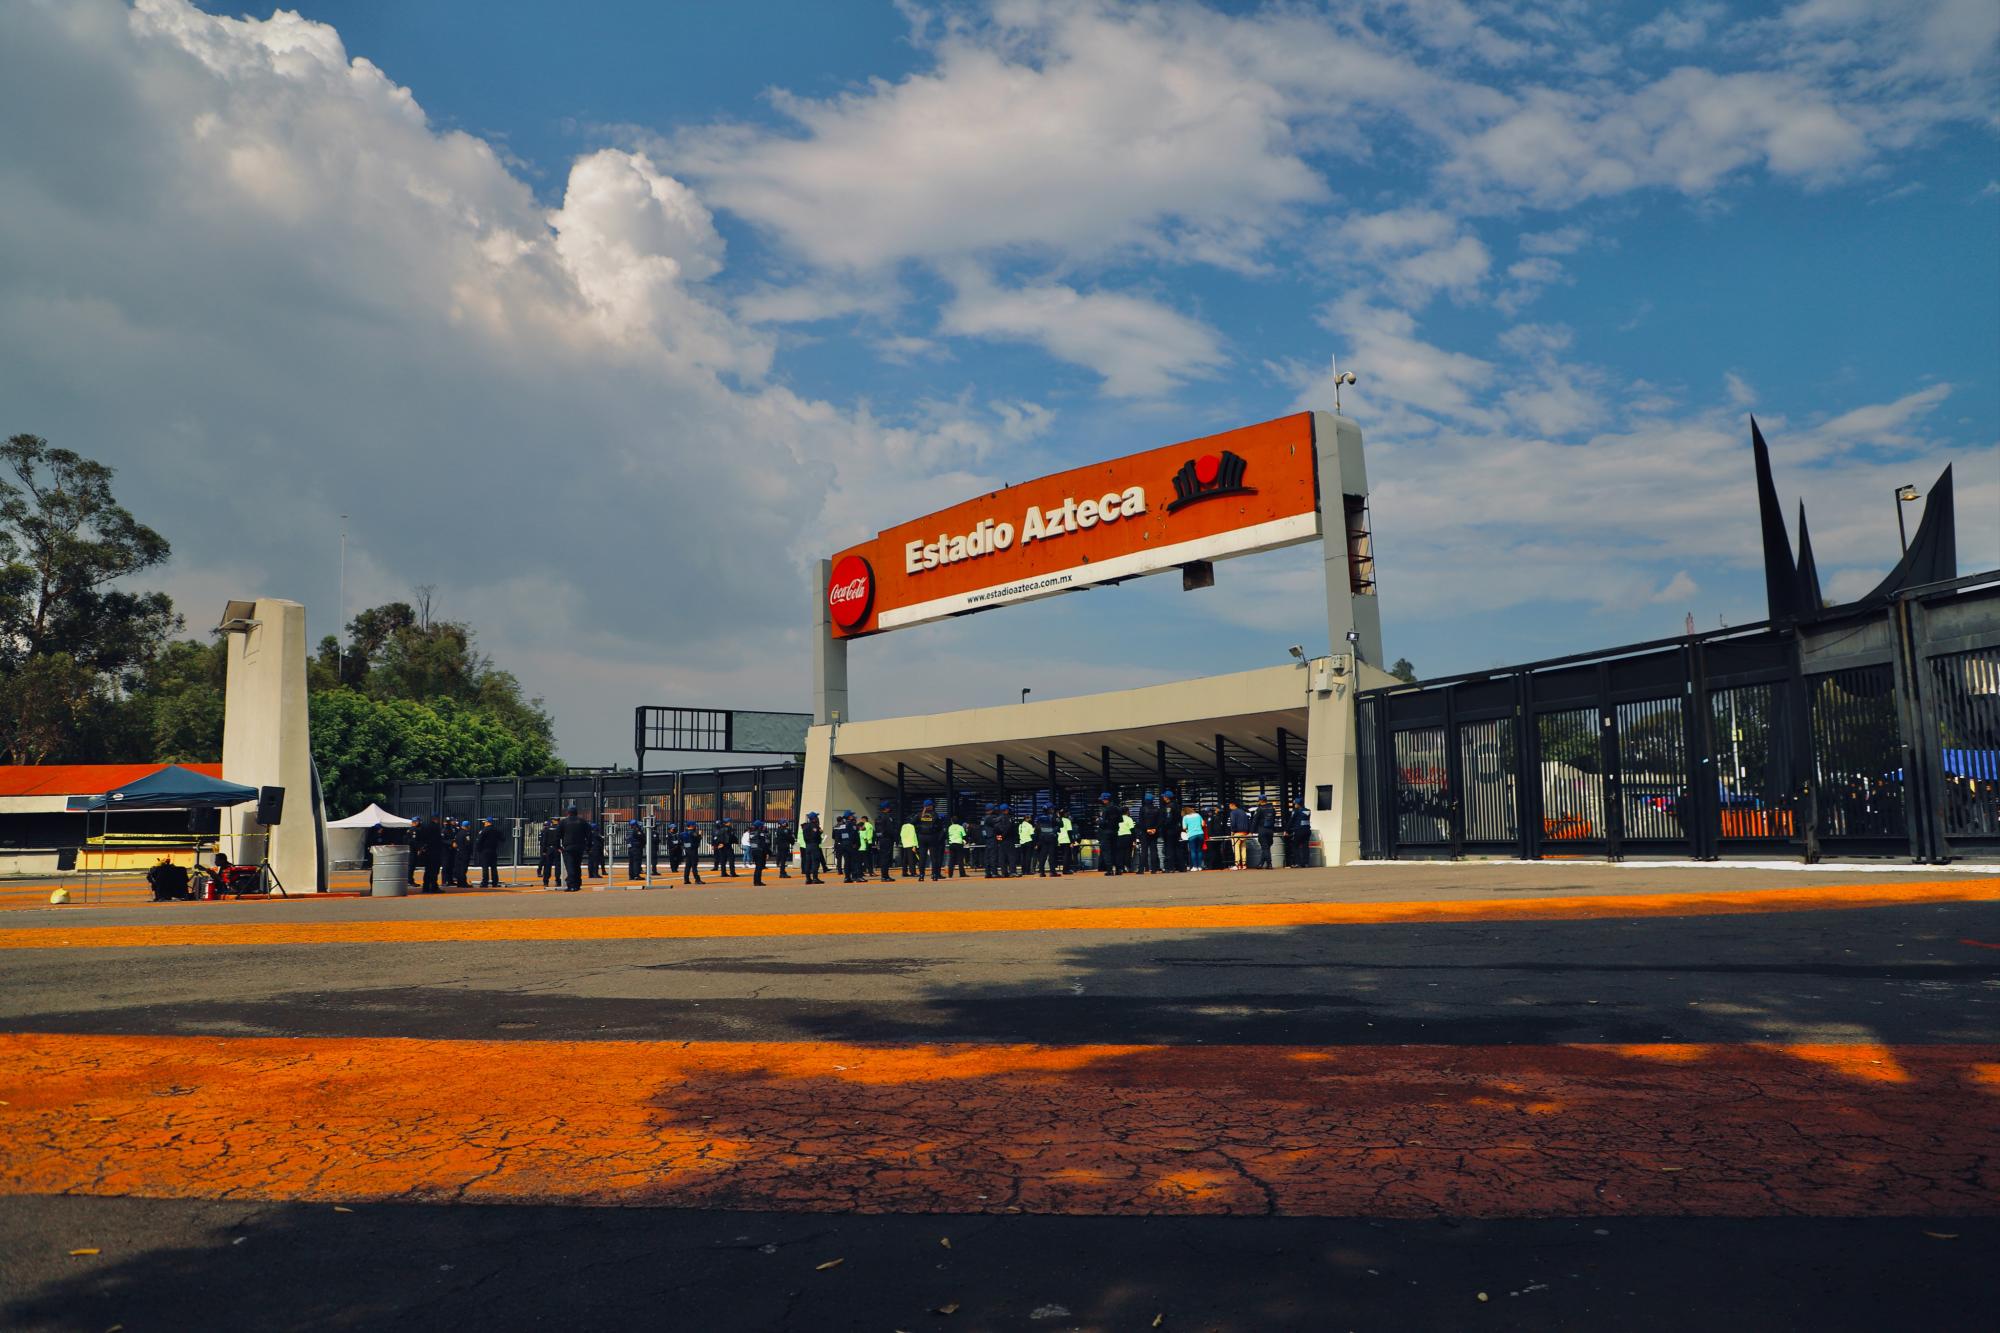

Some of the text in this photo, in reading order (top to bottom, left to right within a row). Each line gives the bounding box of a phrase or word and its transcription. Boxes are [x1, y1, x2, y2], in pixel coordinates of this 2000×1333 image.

[905, 486, 1146, 574] Estadio Azteca
[967, 574, 1073, 604] www.estadioazteca.com.mx
